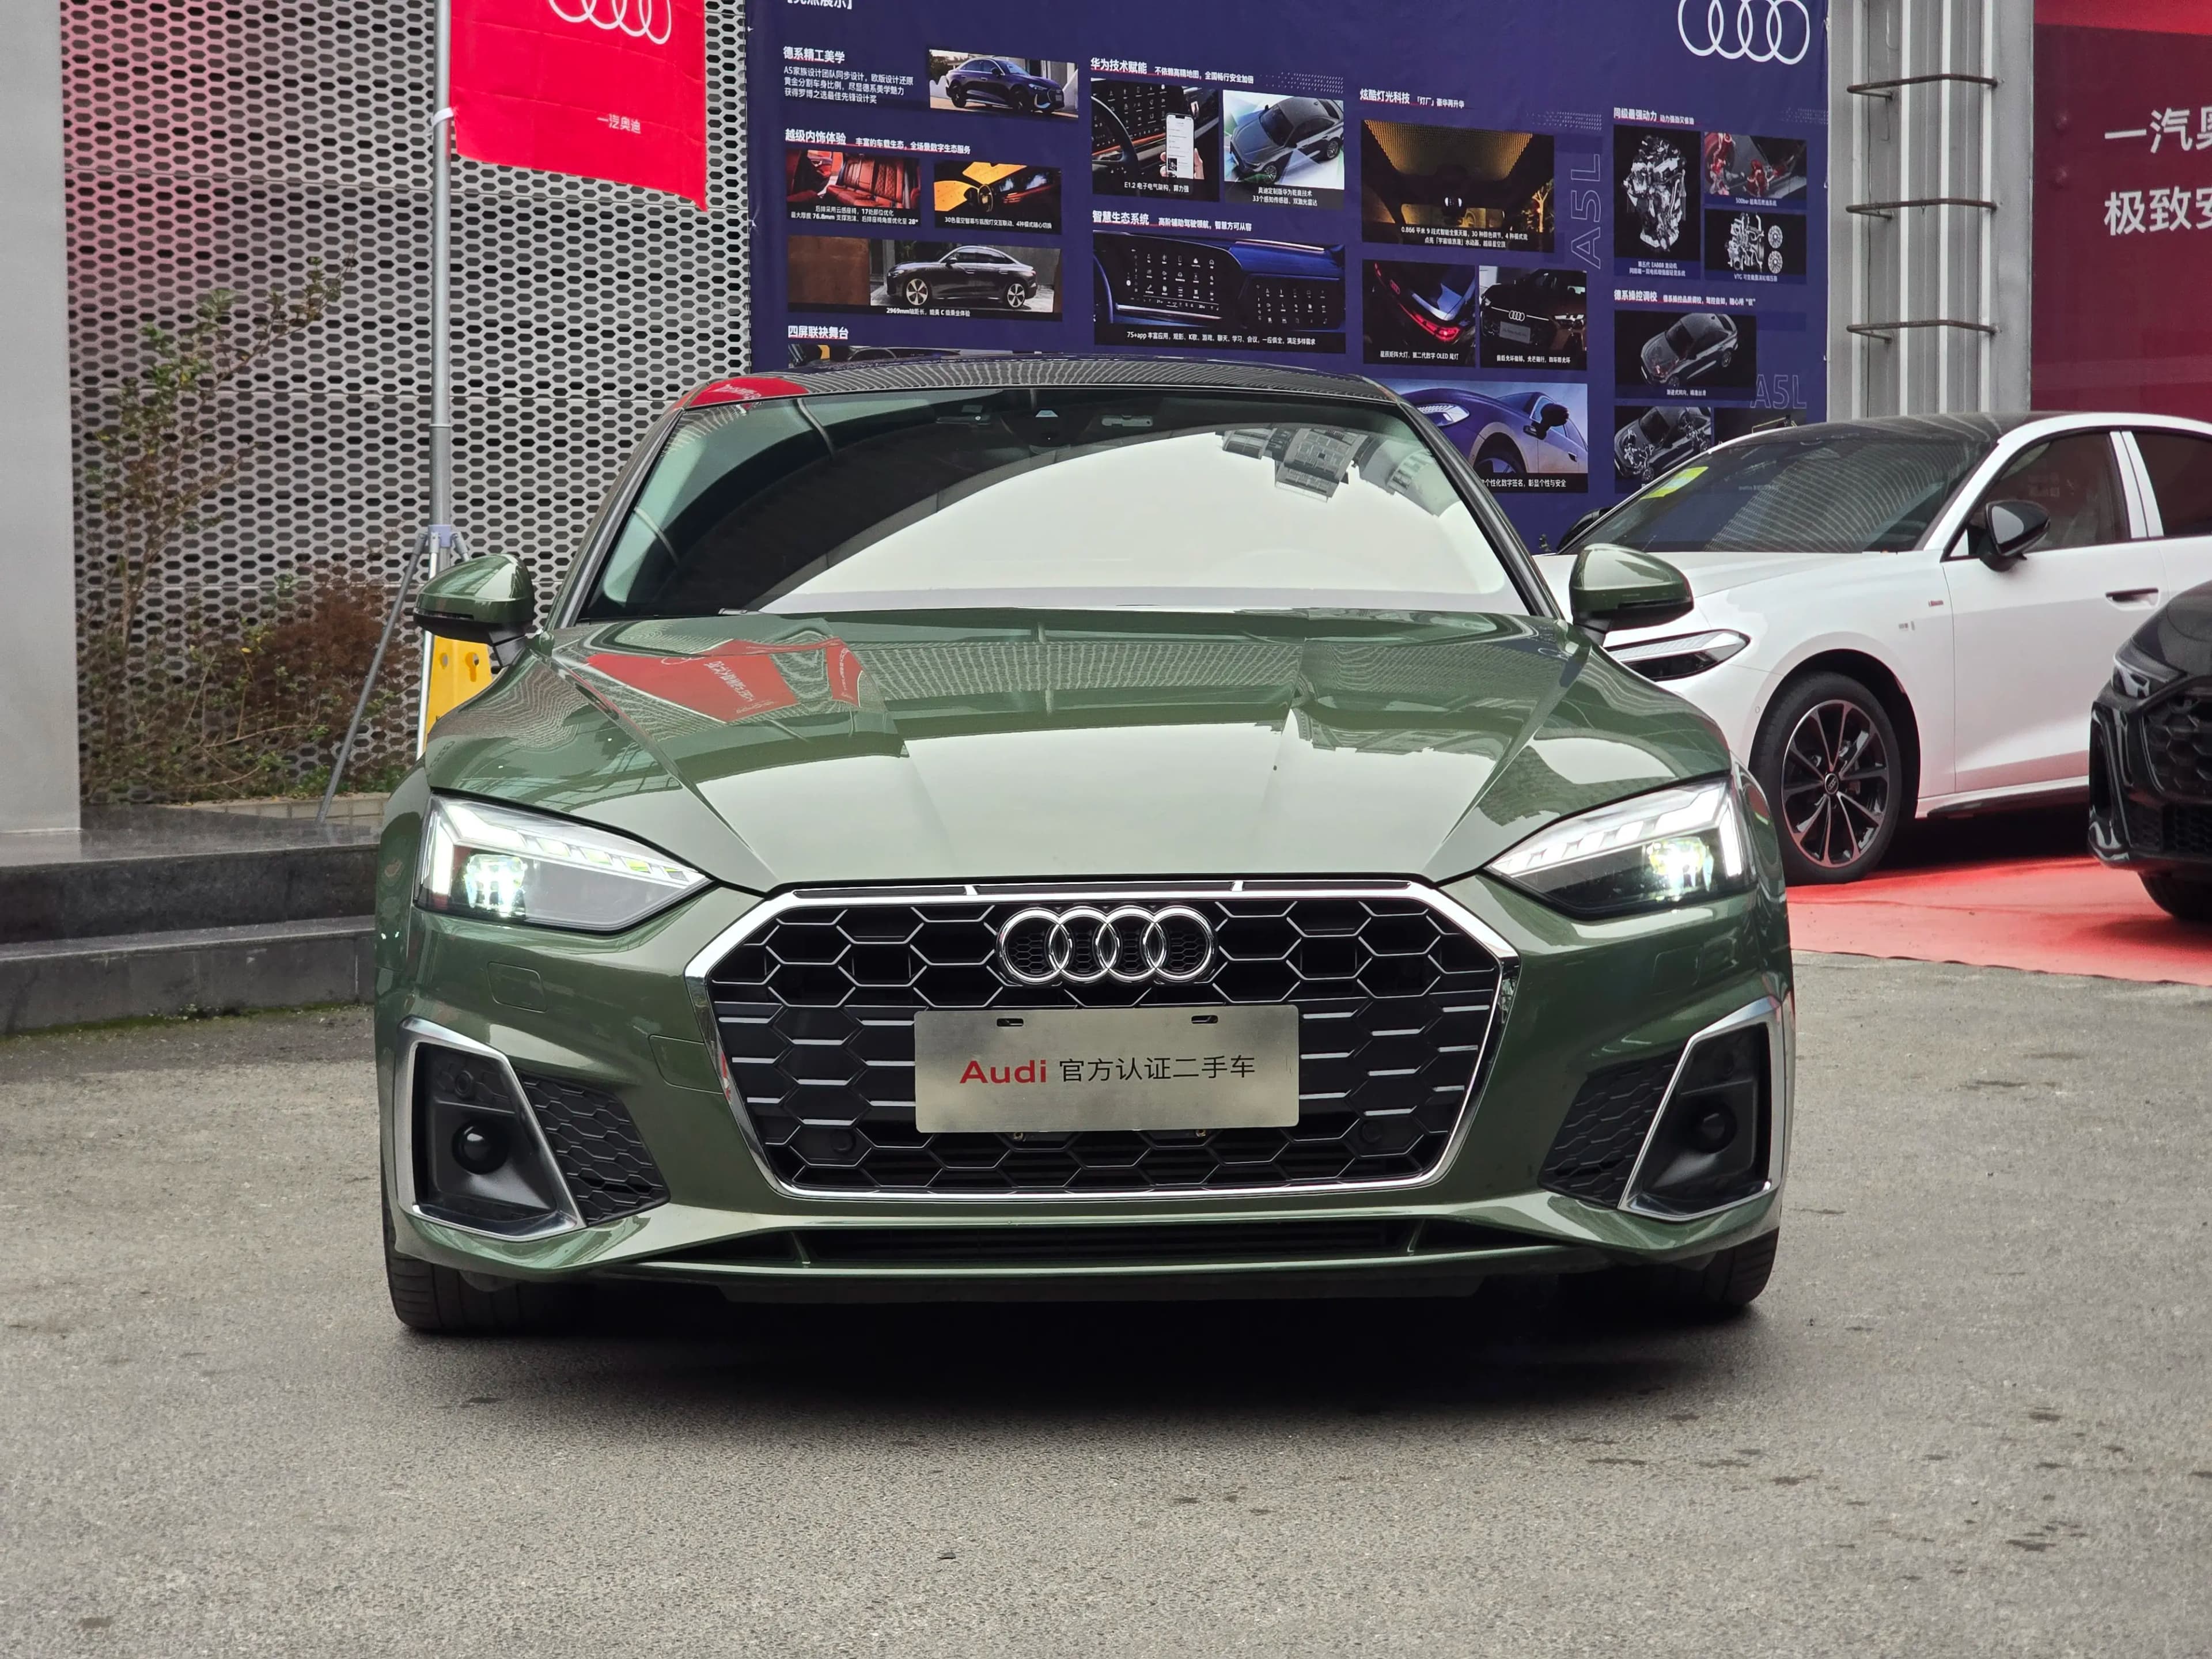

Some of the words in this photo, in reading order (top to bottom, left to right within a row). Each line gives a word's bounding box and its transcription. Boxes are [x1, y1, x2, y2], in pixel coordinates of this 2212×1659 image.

[783, 46, 845, 64] 德系精工美学
[1090, 57, 1147, 74] 华为技术赋能
[785, 88, 877, 104] 获得罗博之选最佳先锋设计奖
[1359, 88, 1410, 104] 炫酷灯光科技
[597, 113, 641, 134] 一汽奥迪
[785, 128, 846, 145] 越级内饰体验
[1092, 210, 1149, 225] 智慧生态系统
[1570, 153, 1601, 270] A5L
[1613, 289, 1657, 302] 德系操控调校
[788, 325, 849, 339] 四屏联袂舞台
[1750, 374, 1807, 410] A5L
[959, 1059, 1047, 1084] Audi
[1059, 1055, 1256, 1084] 官方认证二手车
